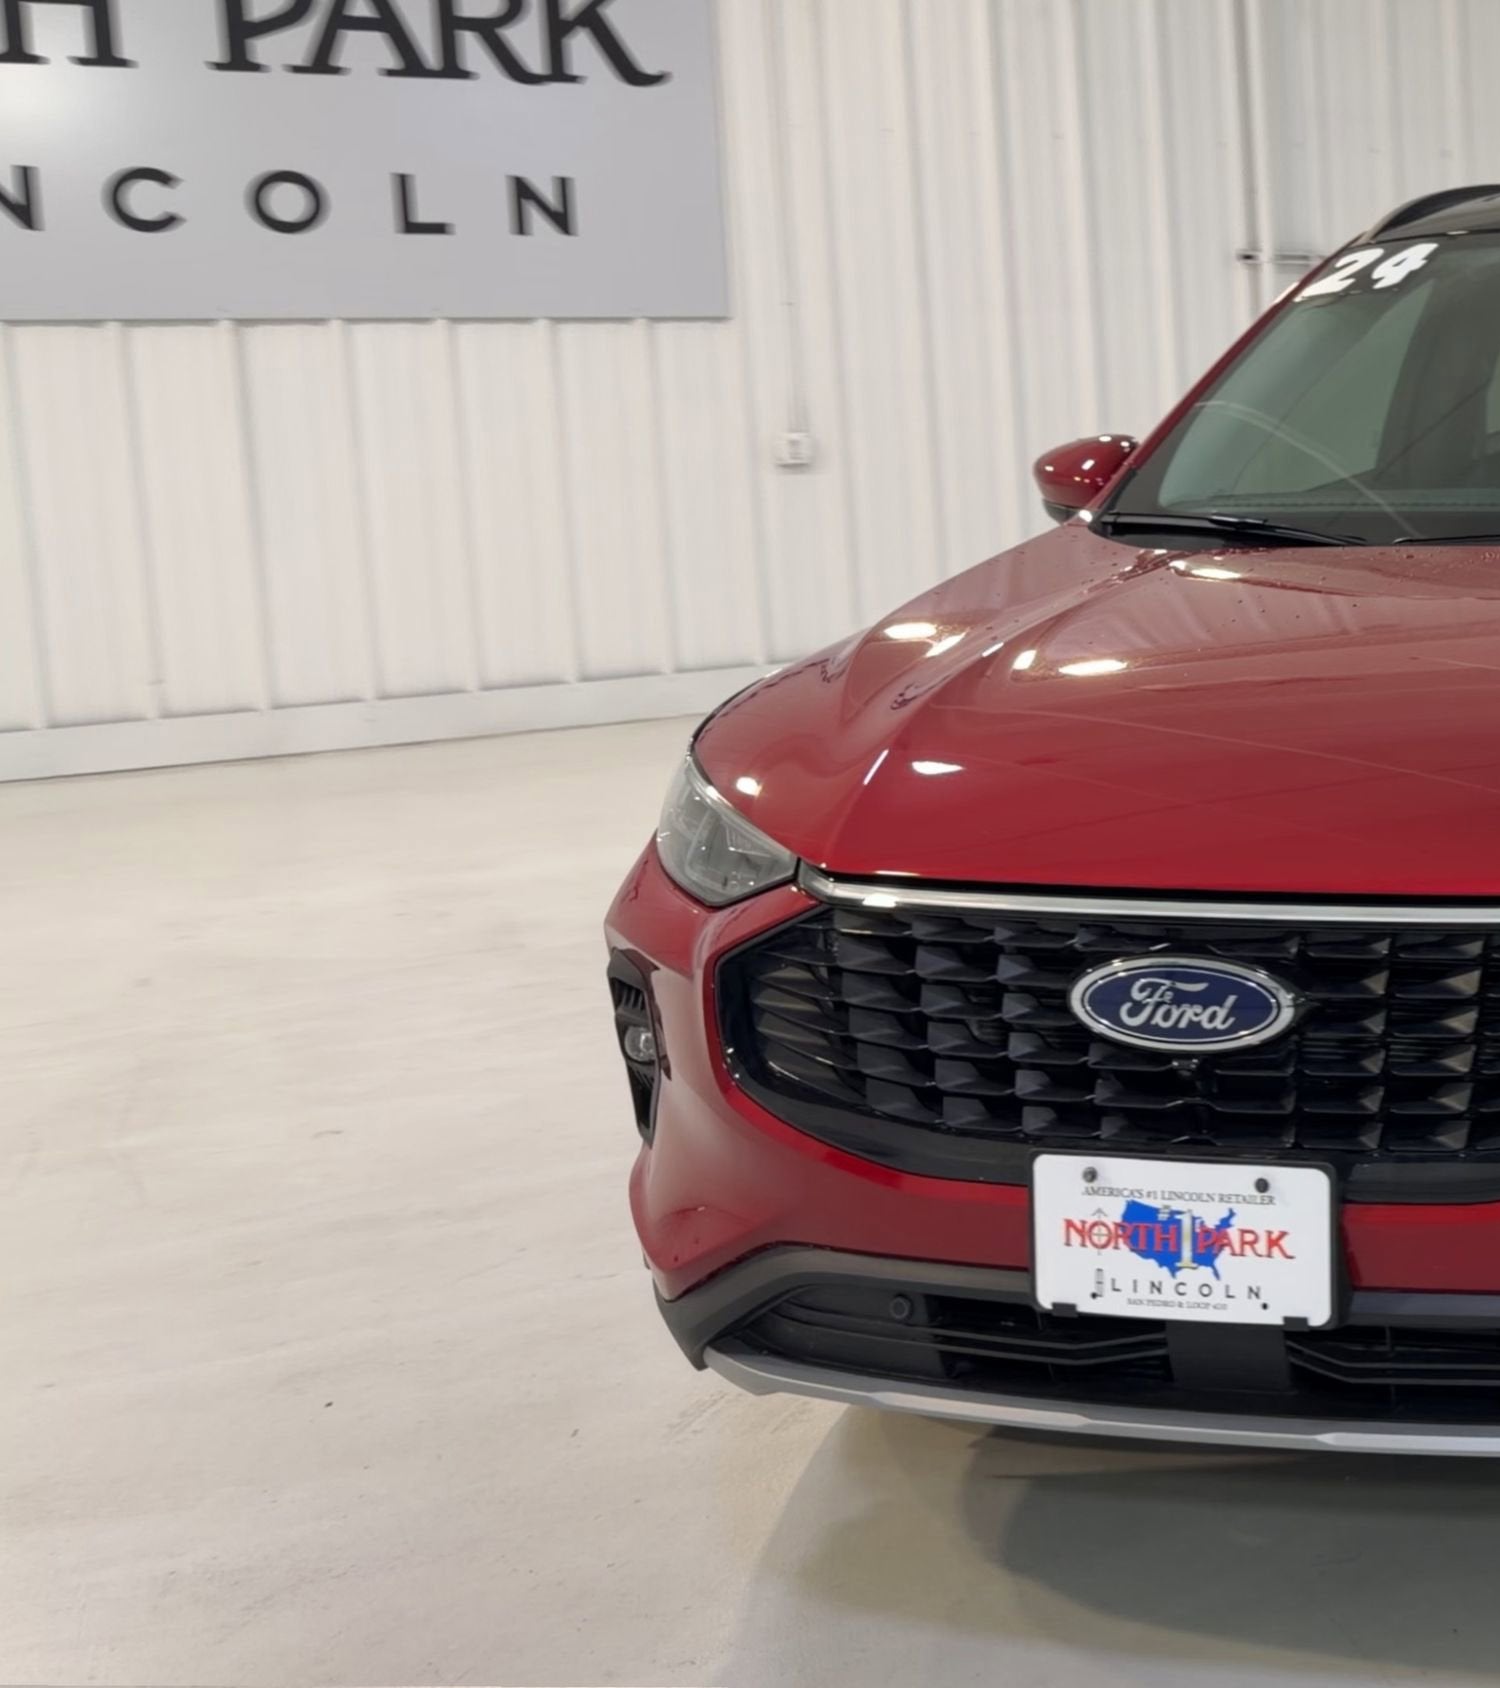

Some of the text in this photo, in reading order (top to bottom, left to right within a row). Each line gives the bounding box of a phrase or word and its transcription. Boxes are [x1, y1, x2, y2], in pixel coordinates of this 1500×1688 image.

[203, 0, 673, 87] PARK
[1294, 243, 1439, 302] 24
[1120, 978, 1238, 1030] Ford
[1161, 1190, 1216, 1203] LINCOLN
[1218, 1192, 1276, 1205] RETAILER
[1063, 1218, 1296, 1259] NORTH PARK
[1110, 1277, 1262, 1300] LINCOLN
